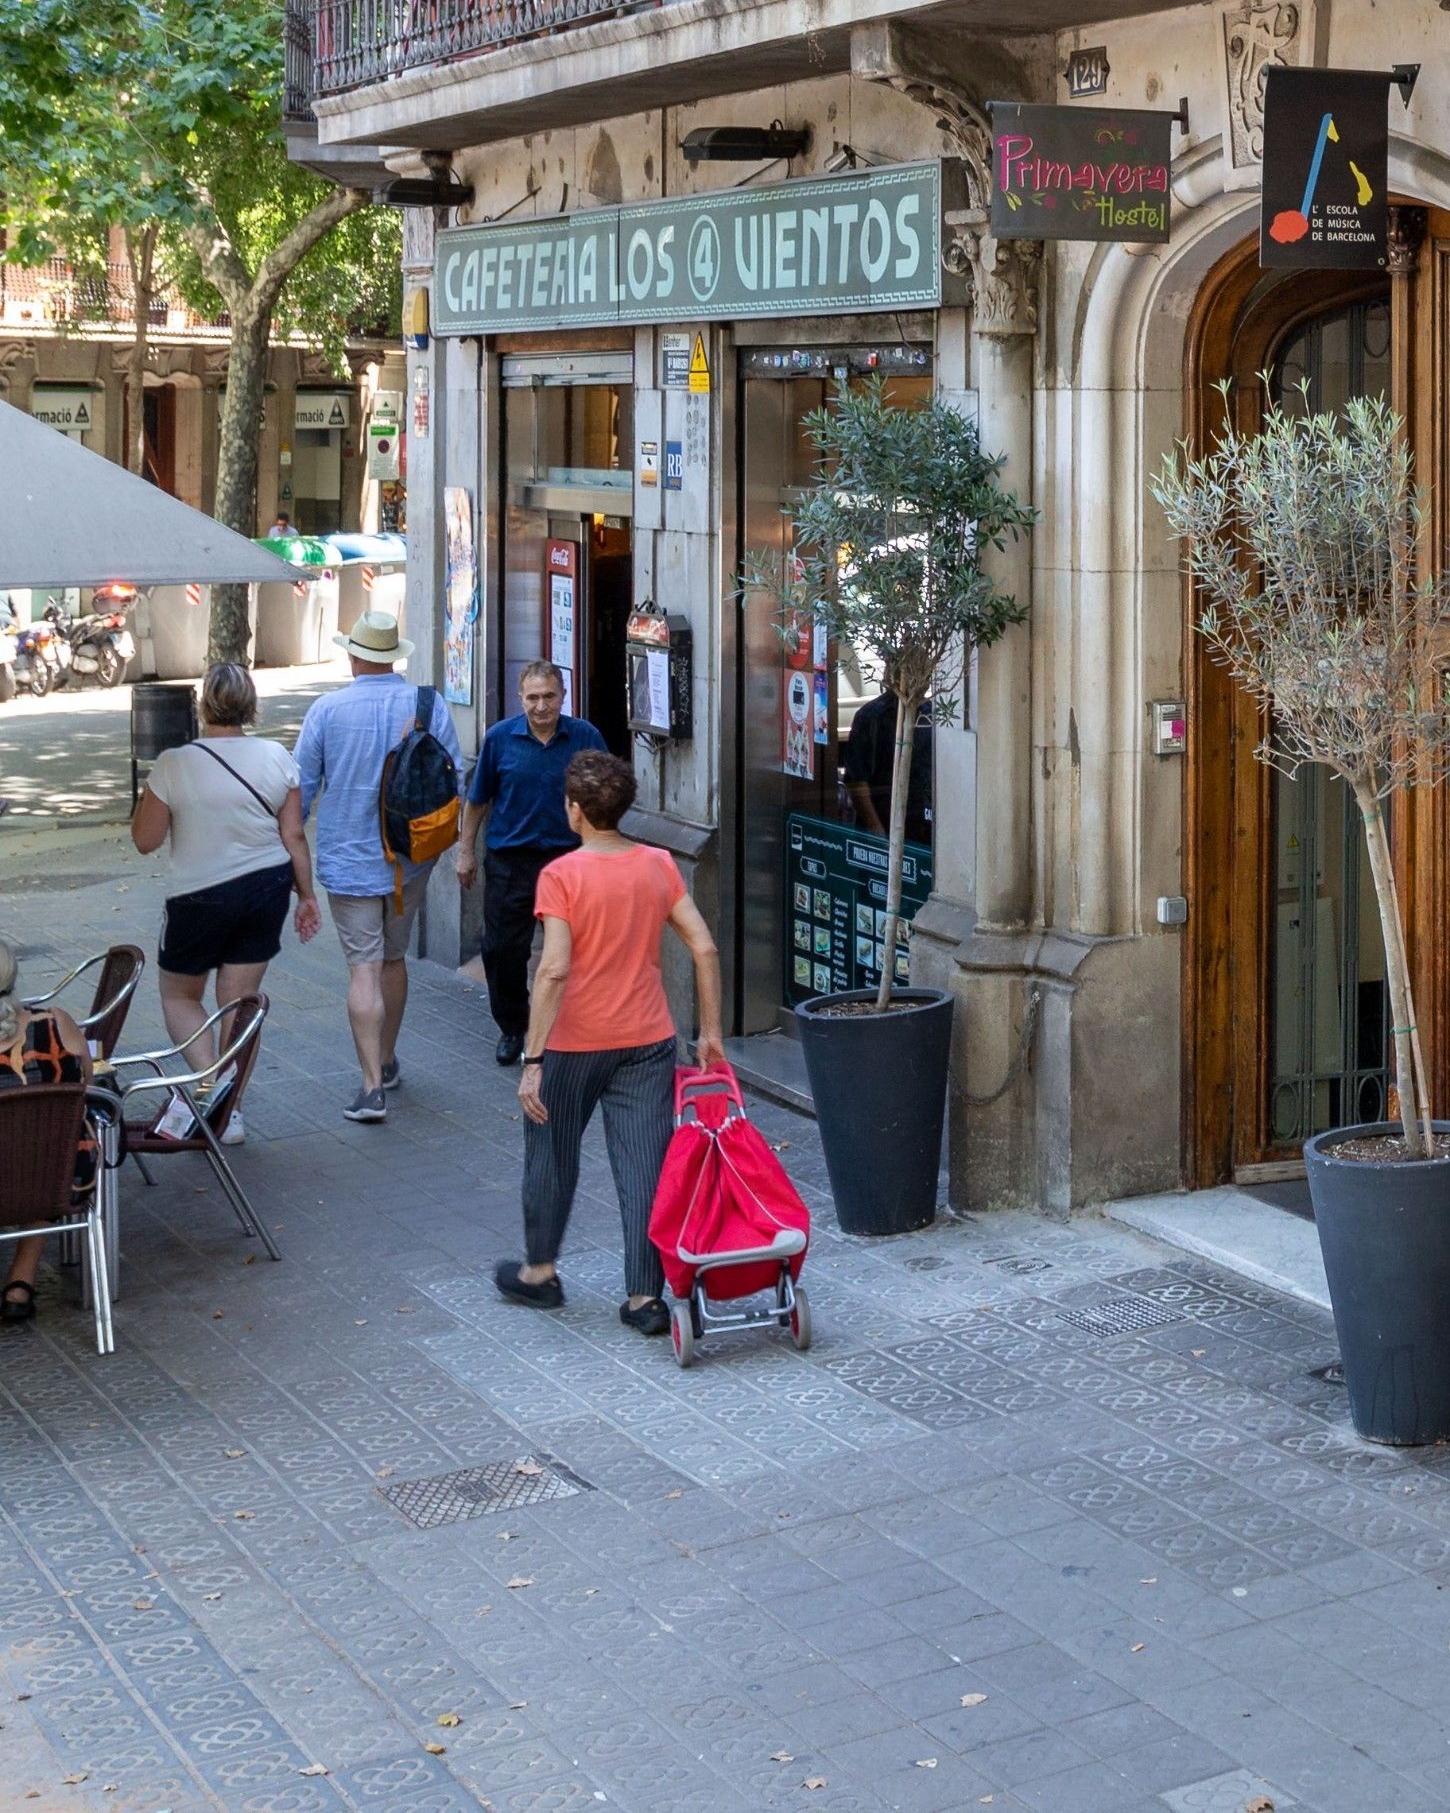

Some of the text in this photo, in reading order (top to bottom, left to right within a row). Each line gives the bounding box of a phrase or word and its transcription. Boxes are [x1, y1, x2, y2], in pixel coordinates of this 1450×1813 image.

[1071, 56, 1103, 92] 129
[996, 134, 1169, 194] Primavera
[1095, 195, 1165, 231] Hostel
[1312, 218, 1361, 229] DE MÚSICA
[1326, 205, 1359, 215] ESCOLA
[1312, 232, 1376, 242] DE BARCELONA
[444, 193, 920, 313] CAFETERIA LOS 4 VIENTOS
[667, 453, 683, 478] RB
